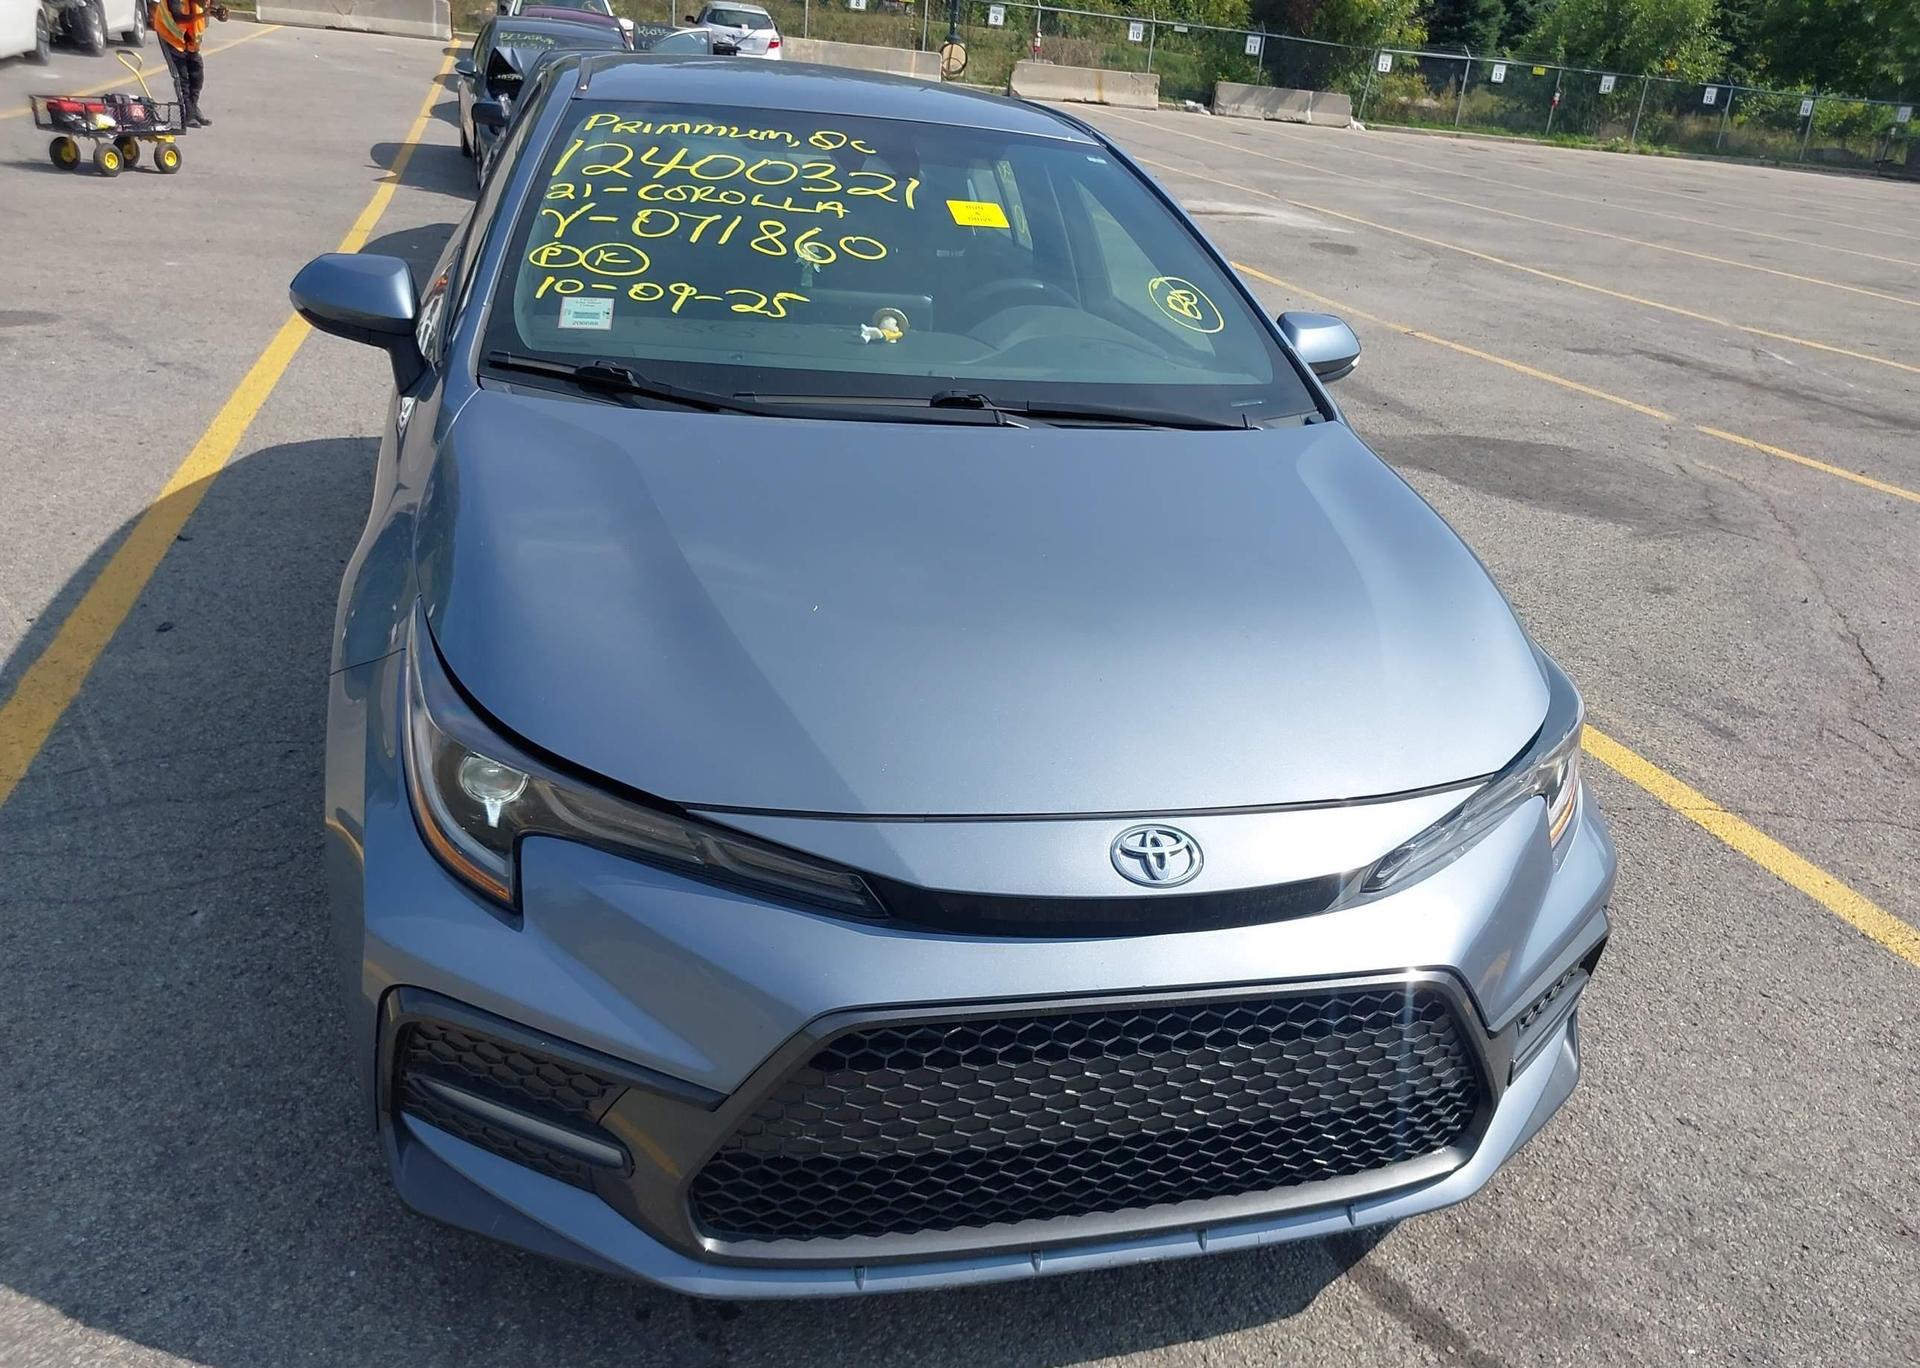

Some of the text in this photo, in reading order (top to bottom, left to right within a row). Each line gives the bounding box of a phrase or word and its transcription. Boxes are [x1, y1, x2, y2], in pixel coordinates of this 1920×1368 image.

[992, 14, 1000, 23] 9
[1131, 31, 1141, 40] 10
[1248, 44, 1258, 53] 11
[1380, 62, 1389, 71] 12
[1494, 72, 1502, 81] 13
[1603, 83, 1611, 92] 14
[1706, 95, 1714, 103] 15
[552, 138, 921, 210] 12400321
[535, 276, 811, 319] 10-09-25
